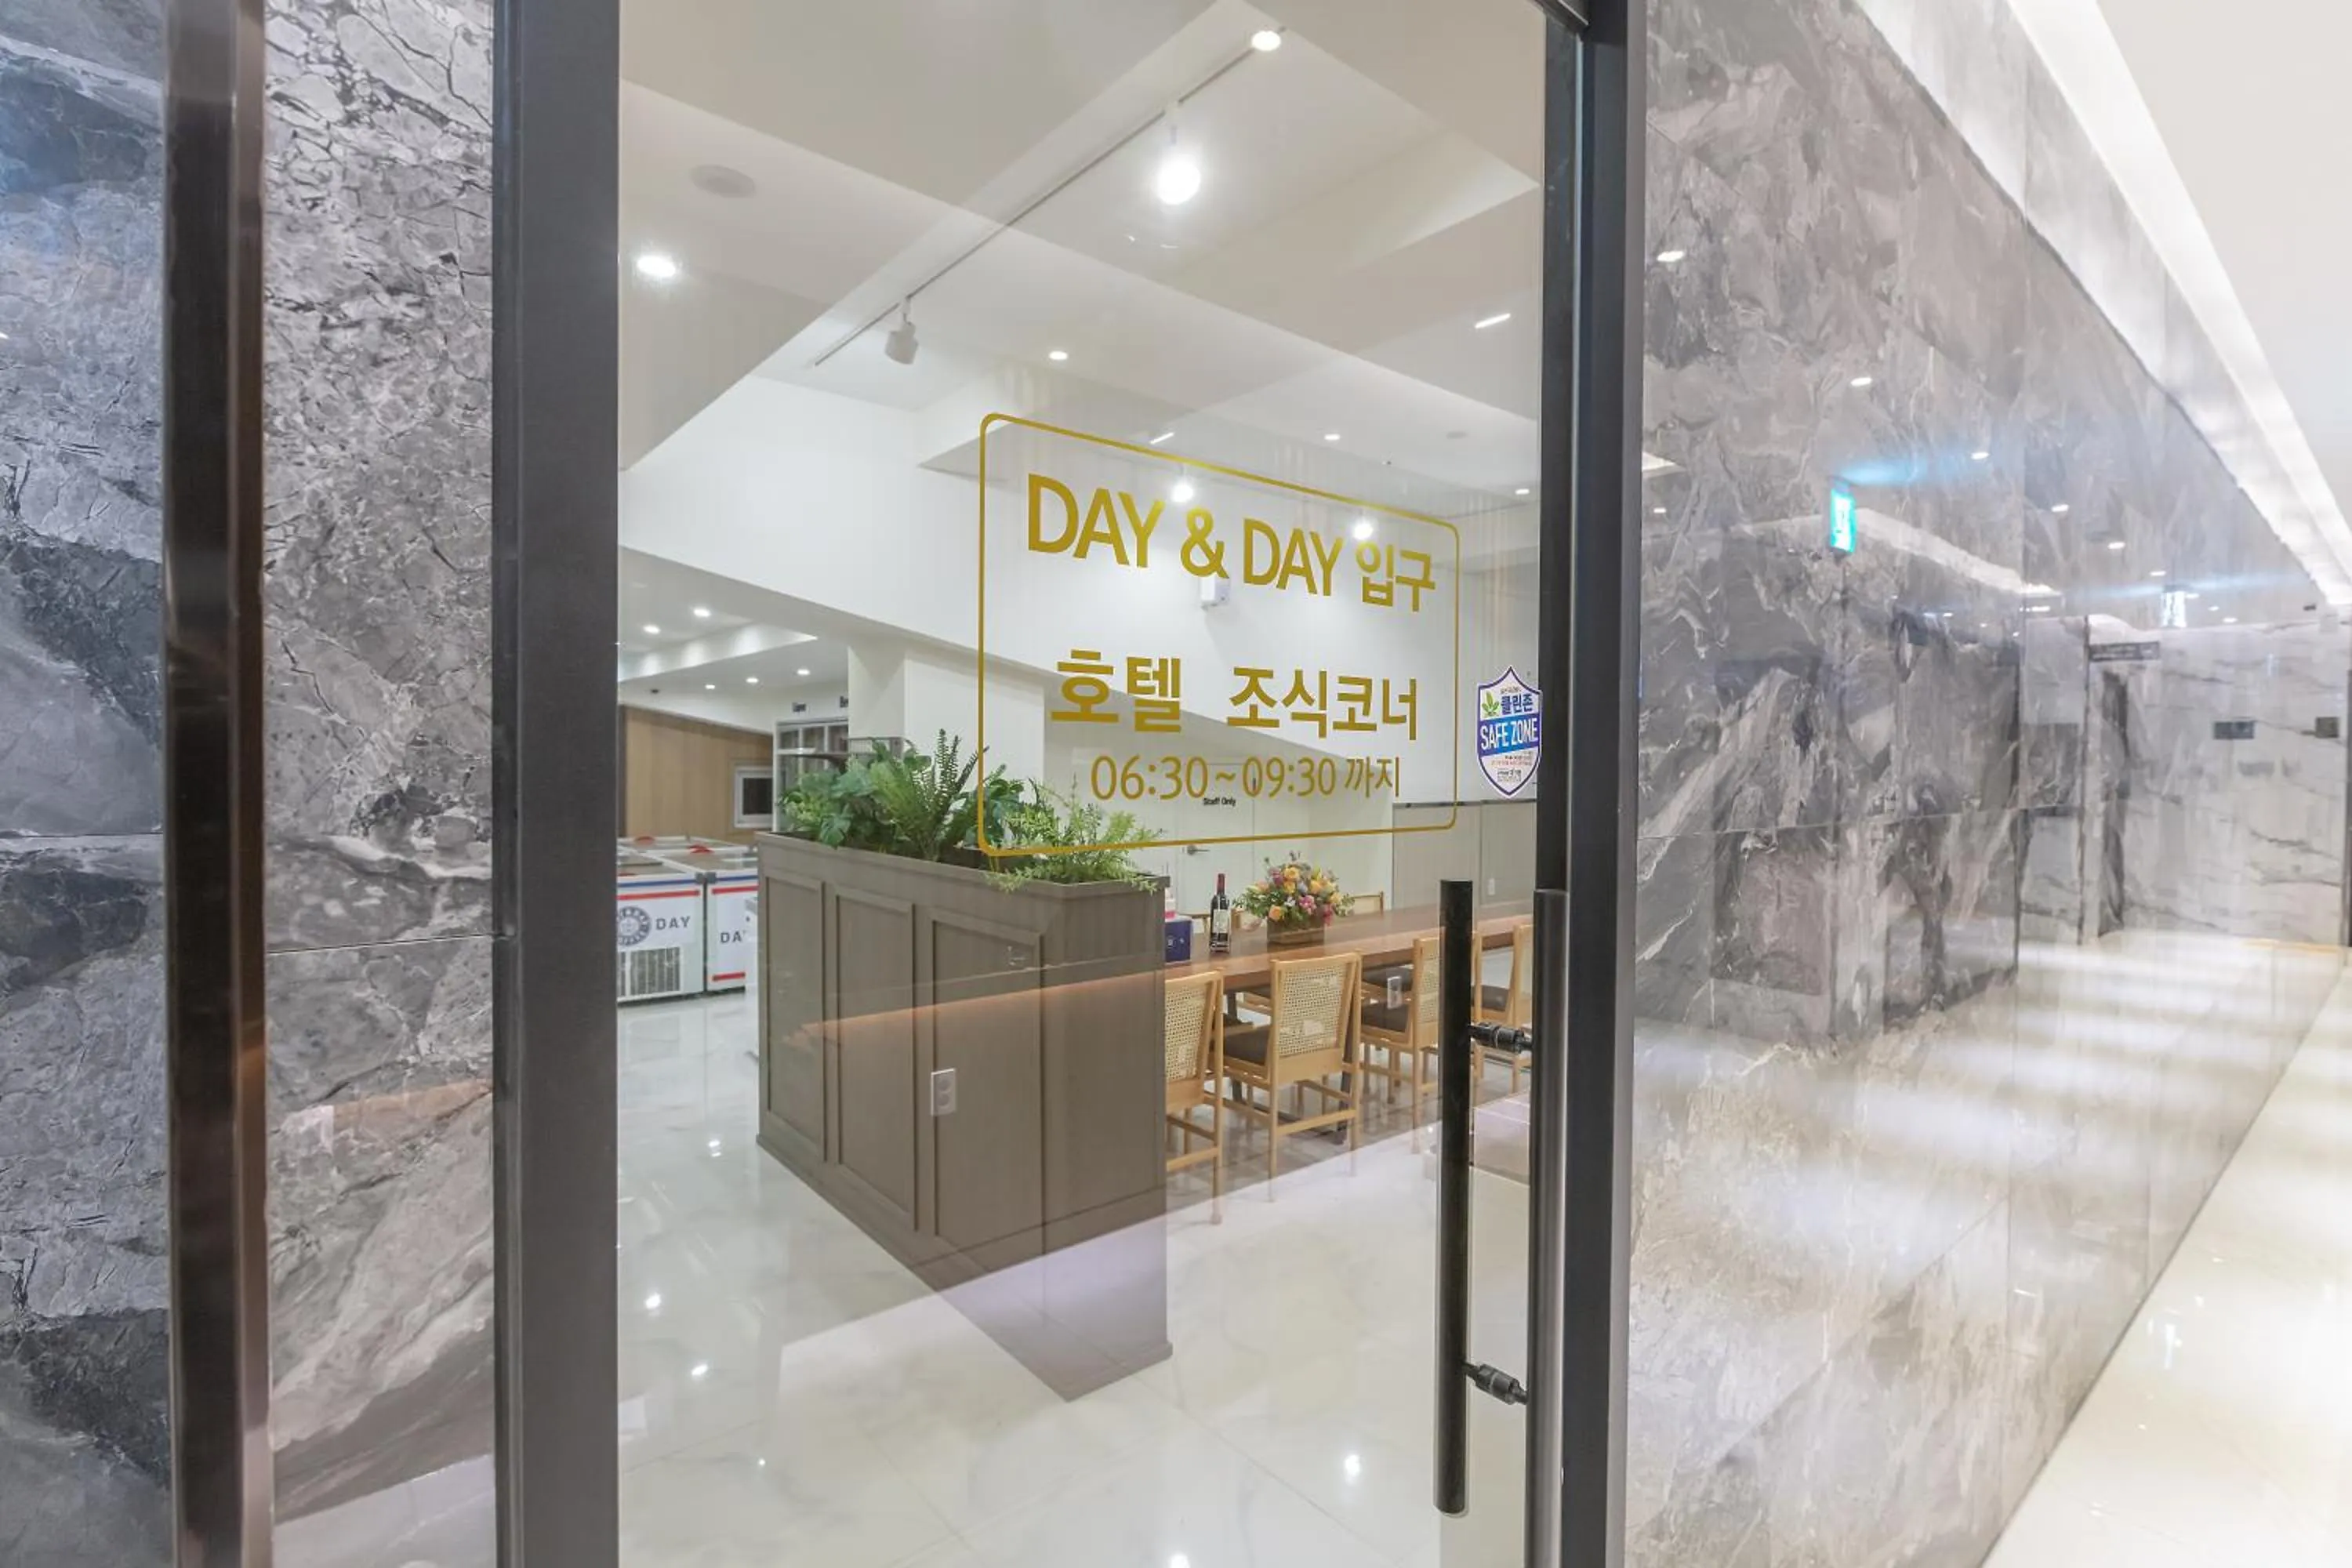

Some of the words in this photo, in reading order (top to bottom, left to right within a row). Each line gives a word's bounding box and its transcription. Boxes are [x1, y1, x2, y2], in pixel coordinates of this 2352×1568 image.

[1028, 473, 1164, 568] DAY
[1180, 506, 1229, 579] &
[1243, 518, 1344, 597] DAY
[1356, 542, 1436, 612] 입구
[1051, 648, 1182, 733] 호텔
[1227, 666, 1417, 740] 조식코너
[1501, 693, 1534, 715] 클린존
[1480, 722, 1508, 750] SAFE
[1510, 718, 1539, 746] ZONE
[1091, 755, 1338, 799] 06:30~09:30
[1343, 757, 1400, 797] 까지
[1203, 797, 1220, 806] Staff
[1221, 796, 1236, 807] Only
[655, 916, 691, 931] DAY
[720, 930, 746, 943] DA
